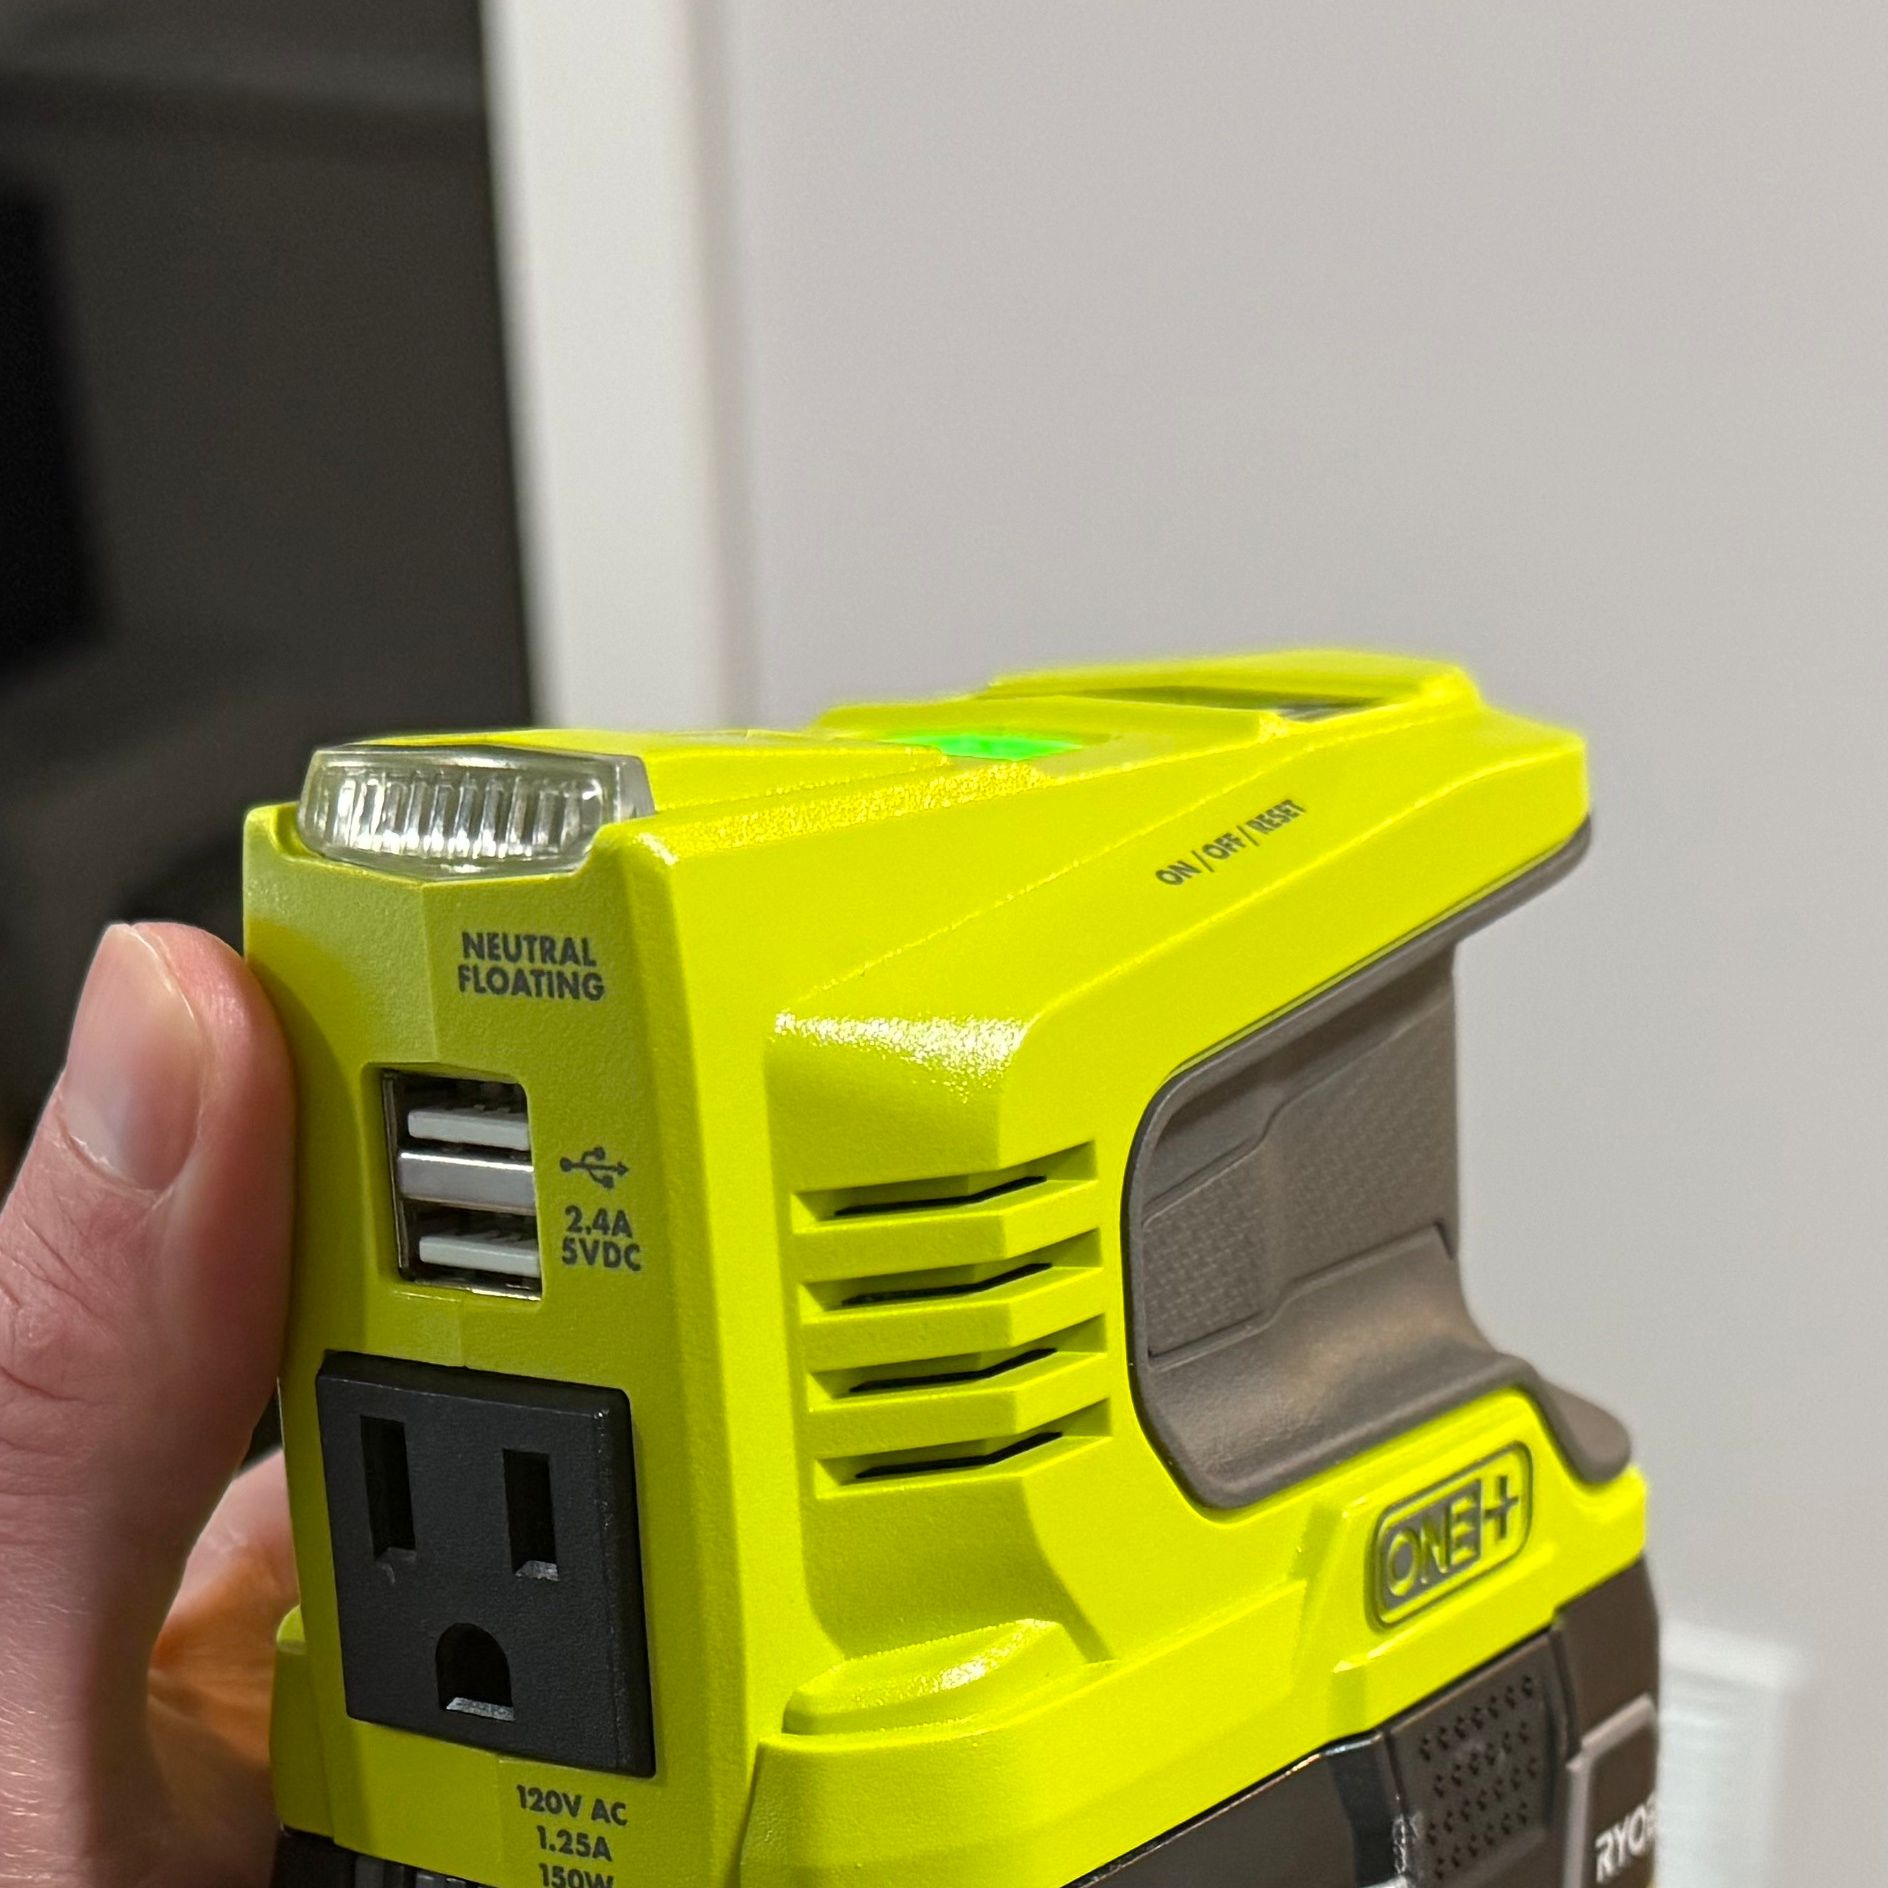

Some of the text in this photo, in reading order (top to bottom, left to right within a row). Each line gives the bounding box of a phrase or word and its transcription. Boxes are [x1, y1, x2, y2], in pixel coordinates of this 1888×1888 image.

[1155, 860, 1202, 886] ON
[1201, 832, 1246, 860] OFF
[1245, 799, 1306, 835] RESET
[462, 931, 597, 967] NEUTRAL
[457, 964, 605, 1001] FLOATING
[564, 1205, 633, 1239] 2.4A
[561, 1236, 642, 1272] 5VDC
[516, 1784, 628, 1826] 120V AC
[536, 1825, 613, 1862] 1.25A
